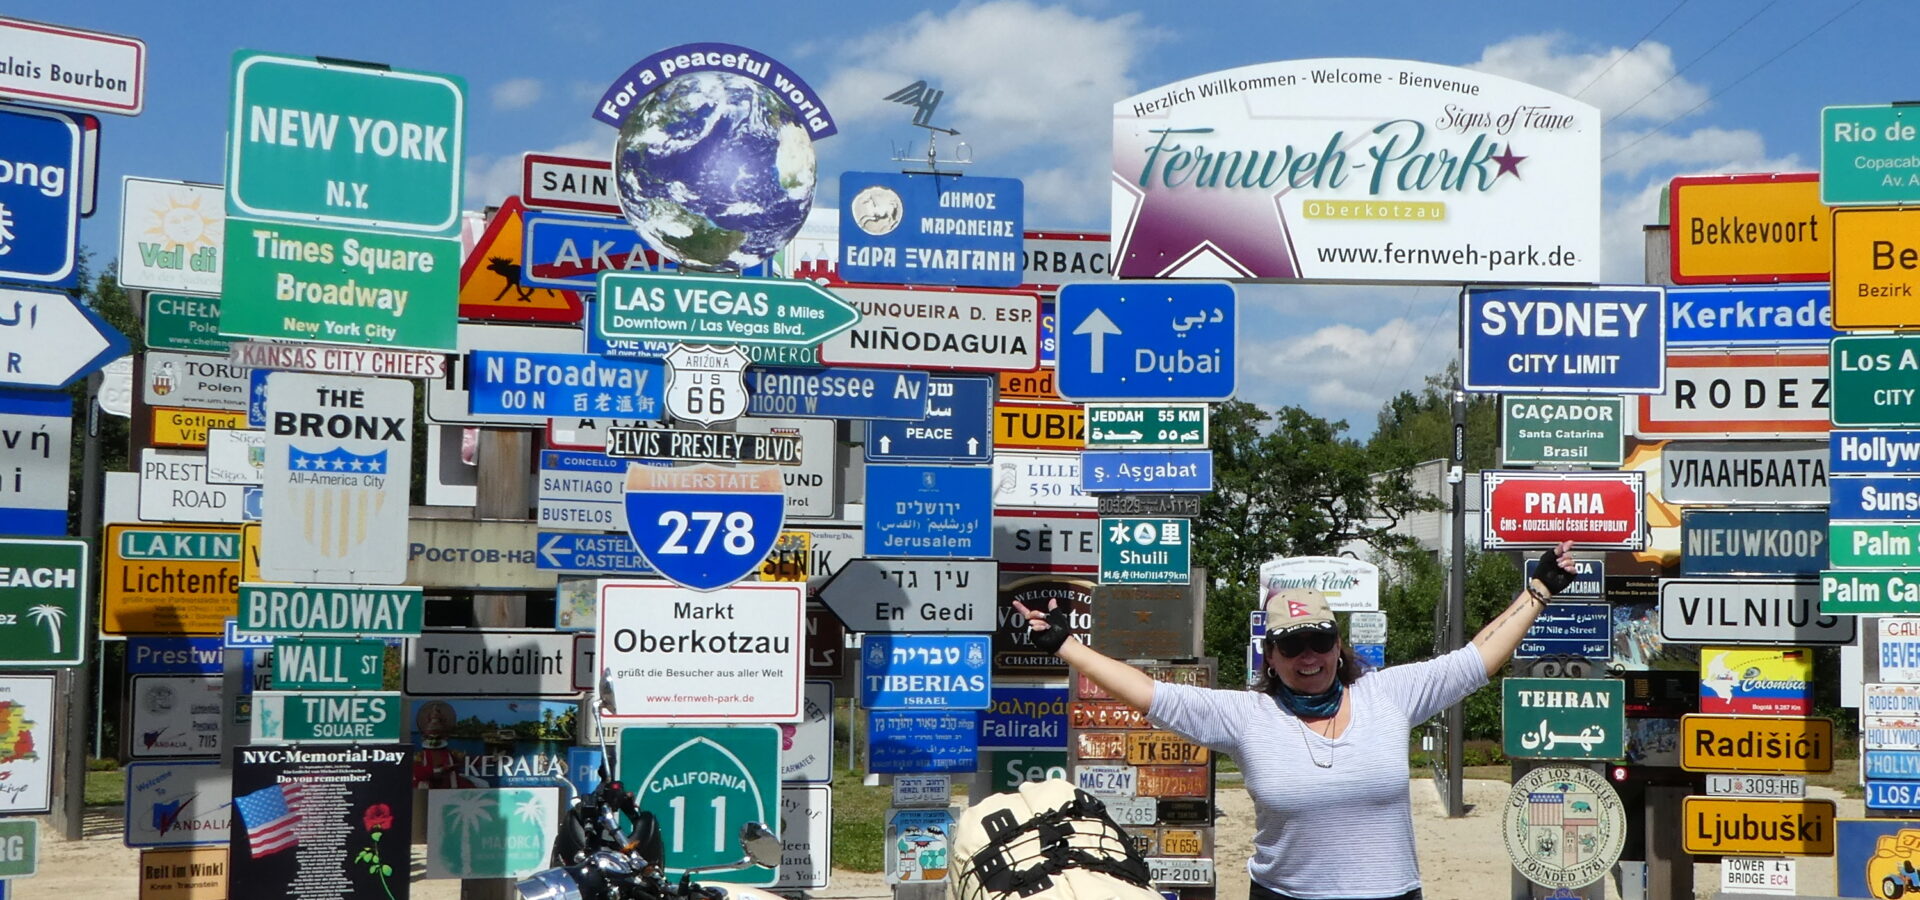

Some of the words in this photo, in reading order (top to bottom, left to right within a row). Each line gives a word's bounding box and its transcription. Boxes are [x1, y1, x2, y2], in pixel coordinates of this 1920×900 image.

[50, 64, 128, 92] Bourbon
[601, 81, 638, 120] For
[640, 69, 658, 85] a
[660, 52, 771, 78] peaceful
[774, 73, 829, 134] world
[1133, 87, 1196, 118] Herzlich
[1199, 73, 1296, 99] Willkommen
[1310, 69, 1382, 84] Welcome
[1399, 71, 1480, 96] Bienvenue
[250, 106, 341, 151] NEW
[348, 117, 447, 163] YORK
[1834, 123, 1876, 142] Rio
[1885, 122, 1915, 141] de
[1139, 119, 1498, 195] Fernweh-Park
[1882, 174, 1905, 186] Av.
[326, 181, 369, 209] N.Y.
[939, 192, 996, 209] ΔΗΜΟΣ
[1309, 203, 1440, 218] Oberkotzau
[921, 218, 1014, 238] ΜΑΡΩΝΕΙΑΣ
[1691, 215, 1819, 245] Bekkevoort
[138, 242, 184, 270] Val
[190, 247, 217, 273] di
[253, 230, 334, 264] Times
[342, 239, 435, 274] Square
[847, 246, 897, 268] ΕΔΡΑ
[905, 247, 1015, 272] ΞΥΛΑΓΑΝΗ
[1317, 242, 1576, 270] www.fernweh-park.de
[276, 273, 408, 316] Broadway
[1858, 284, 1912, 297] Bezirk
[614, 286, 665, 312] LAS
[674, 289, 769, 317] VEGAS
[777, 305, 786, 318] 8
[790, 306, 825, 320] Miles
[1172, 307, 1224, 338] دبي
[1481, 301, 1648, 338] SYDNEY
[1672, 299, 1831, 329] Kerkrade
[284, 317, 320, 332] New
[324, 320, 360, 336] York
[365, 323, 396, 341] City
[613, 316, 688, 331] Downtown
[700, 319, 722, 332] Las
[727, 321, 770, 336] Vegas
[773, 323, 806, 336] Blvd.
[850, 326, 1028, 355] NIÑODAGUIA
[243, 345, 316, 367] KANSAS
[324, 349, 366, 370] CITY
[372, 351, 435, 375] CHIEFS
[686, 354, 729, 368] ARIZONA
[1135, 348, 1221, 374] Dubai
[1508, 354, 1558, 373] CITY
[1564, 355, 1620, 374] LIMIT
[487, 357, 504, 384] N
[515, 358, 649, 396] Broadway
[753, 368, 875, 398] Tennessee
[893, 374, 921, 399] Av
[199, 382, 242, 393] Polen
[1675, 378, 1829, 409] RODEZ
[1874, 389, 1915, 406] CITY
[317, 389, 364, 408] THE
[688, 387, 725, 414] 66
[172, 415, 235, 428] Gotland
[1092, 411, 1143, 422] JEDDAH
[1158, 411, 1174, 422] 55
[1179, 411, 1200, 421] KM
[1511, 404, 1613, 423] CAÇADOR
[274, 412, 405, 442] BRONX
[906, 428, 952, 440] PEACE
[1519, 430, 1551, 438] Santa
[1556, 430, 1604, 438] Catarina
[616, 431, 659, 456] ELVIS
[671, 432, 744, 460] PRESLEY
[755, 437, 793, 461] BLVD
[1543, 446, 1588, 457] Brasil
[564, 457, 617, 468] CONCELLO
[1028, 464, 1079, 477] LILLE
[289, 475, 358, 486] All-America
[363, 476, 385, 489] City
[651, 472, 760, 489] INTERSTATE
[1669, 459, 1828, 488] УЛААНБААТА
[544, 479, 613, 494] SANTIAGO
[173, 490, 226, 508] ROAD
[896, 500, 960, 515] ירושלים
[1525, 492, 1604, 514] PRAHA
[543, 508, 612, 523] BUSTELOS
[1500, 517, 1517, 531] ČMS
[1523, 517, 1565, 531] KOUZELNÍCI
[1566, 517, 1588, 531] ČESKÉ
[1590, 520, 1627, 532] REPUBLIKY
[657, 510, 755, 556] 278
[884, 534, 971, 547] Jerusalem
[1688, 529, 1824, 557] NIEUWKOOP
[1853, 530, 1910, 555] Palm
[409, 542, 535, 564] Ростов-на
[1120, 550, 1168, 564] Shuili
[880, 571, 918, 588] גדי
[934, 571, 969, 591] עין
[250, 591, 411, 630] BROADWAY
[674, 602, 735, 620] Markt
[876, 603, 904, 621] En
[921, 603, 973, 621] Gedi
[1287, 623, 1322, 632] NEPAL
[614, 629, 790, 654] Oberkotzau
[1521, 644, 1545, 652] Cairo
[279, 646, 348, 682] WALL
[361, 655, 378, 674] ST
[424, 647, 562, 675] Törökbálint
[893, 647, 960, 665] טבריה
[617, 669, 645, 679] grüßt
[648, 669, 662, 677] die
[666, 669, 713, 678] Besucher
[737, 669, 759, 678] aller
[762, 669, 783, 678] Welt
[867, 675, 985, 692] TIBERIAS
[646, 694, 754, 704] www.fernweh-park.de
[1518, 691, 1610, 708] TEHRAN
[302, 698, 386, 723] TIMES
[313, 724, 374, 737] SQUARE
[983, 720, 1058, 737] Faliraki
[1521, 719, 1605, 752] تهران
[1139, 743, 1156, 760] TK
[1162, 743, 1200, 760] 5387
[1696, 729, 1820, 759] Radišići
[243, 750, 405, 764] NYC-Memorial-Day
[464, 754, 563, 777] KERALA
[277, 775, 292, 783] Do
[294, 776, 312, 784] you
[313, 774, 372, 782] remember?
[650, 771, 747, 793] CALIFORNIA
[1080, 774, 1103, 788] MAG
[1512, 787, 1530, 809] CITY
[1531, 775, 1545, 787] OF
[1548, 769, 1570, 779] LOS
[1574, 772, 1616, 810] ANGELES
[1879, 786, 1910, 804] LOS
[1699, 813, 1822, 847] Ljubuški
[1180, 839, 1198, 853] 659
[146, 865, 170, 879] Reit
[172, 865, 186, 877] im
[191, 862, 223, 877] Winkl
[1521, 858, 1576, 882] FOUNDED
[1582, 858, 1606, 878] 1781
[1728, 860, 1764, 871] TOWER
[1729, 872, 1765, 883] BRIDGE
[1771, 875, 1788, 885] EC4
